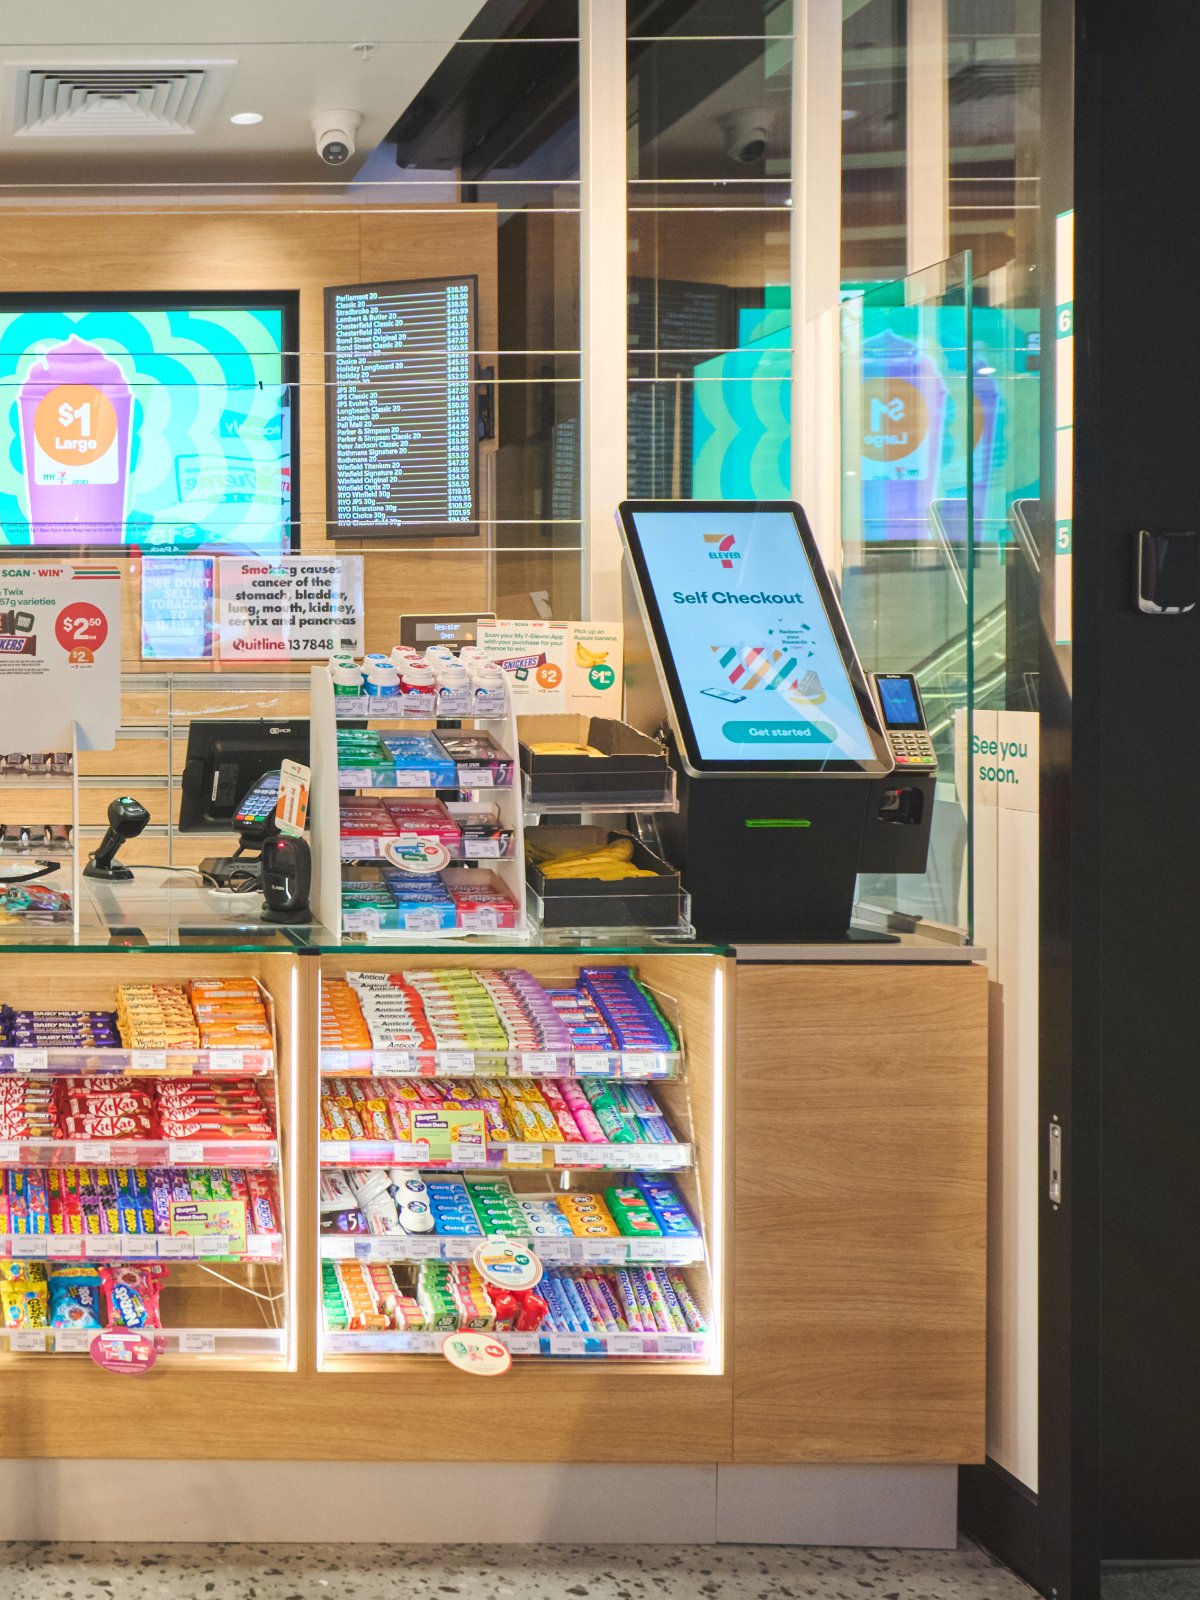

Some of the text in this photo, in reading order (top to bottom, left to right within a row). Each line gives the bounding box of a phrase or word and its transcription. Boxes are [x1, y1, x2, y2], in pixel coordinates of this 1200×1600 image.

[1058, 309, 1071, 332] 6
[58, 402, 91, 436] $1
[55, 436, 97, 453] Large
[1058, 527, 1070, 547] 5
[2, 569, 31, 577] SCAN
[301, 566, 342, 575] causes
[252, 577, 332, 587] cancer of the
[4, 588, 24, 596] Twix
[236, 590, 348, 601] stomach, bladder,
[673, 591, 804, 604] Self Checkout
[18, 598, 56, 606] varieties
[228, 603, 356, 616] lung, mouth, kidney,
[228, 616, 356, 628] cervix and pancreas
[441, 632, 454, 640] Open
[232, 638, 334, 651] Quitline 13 7848
[72, 651, 85, 662] $2
[503, 656, 537, 669] SNICKERS
[542, 670, 557, 682] $2
[749, 728, 811, 736] Get started
[973, 735, 1027, 761] See you
[980, 766, 1018, 784] soon.
[91, 1117, 134, 1135] KitKat
[348, 1214, 357, 1230] 5
[619, 1270, 634, 1306] mentos
[600, 1283, 619, 1319] mentos
